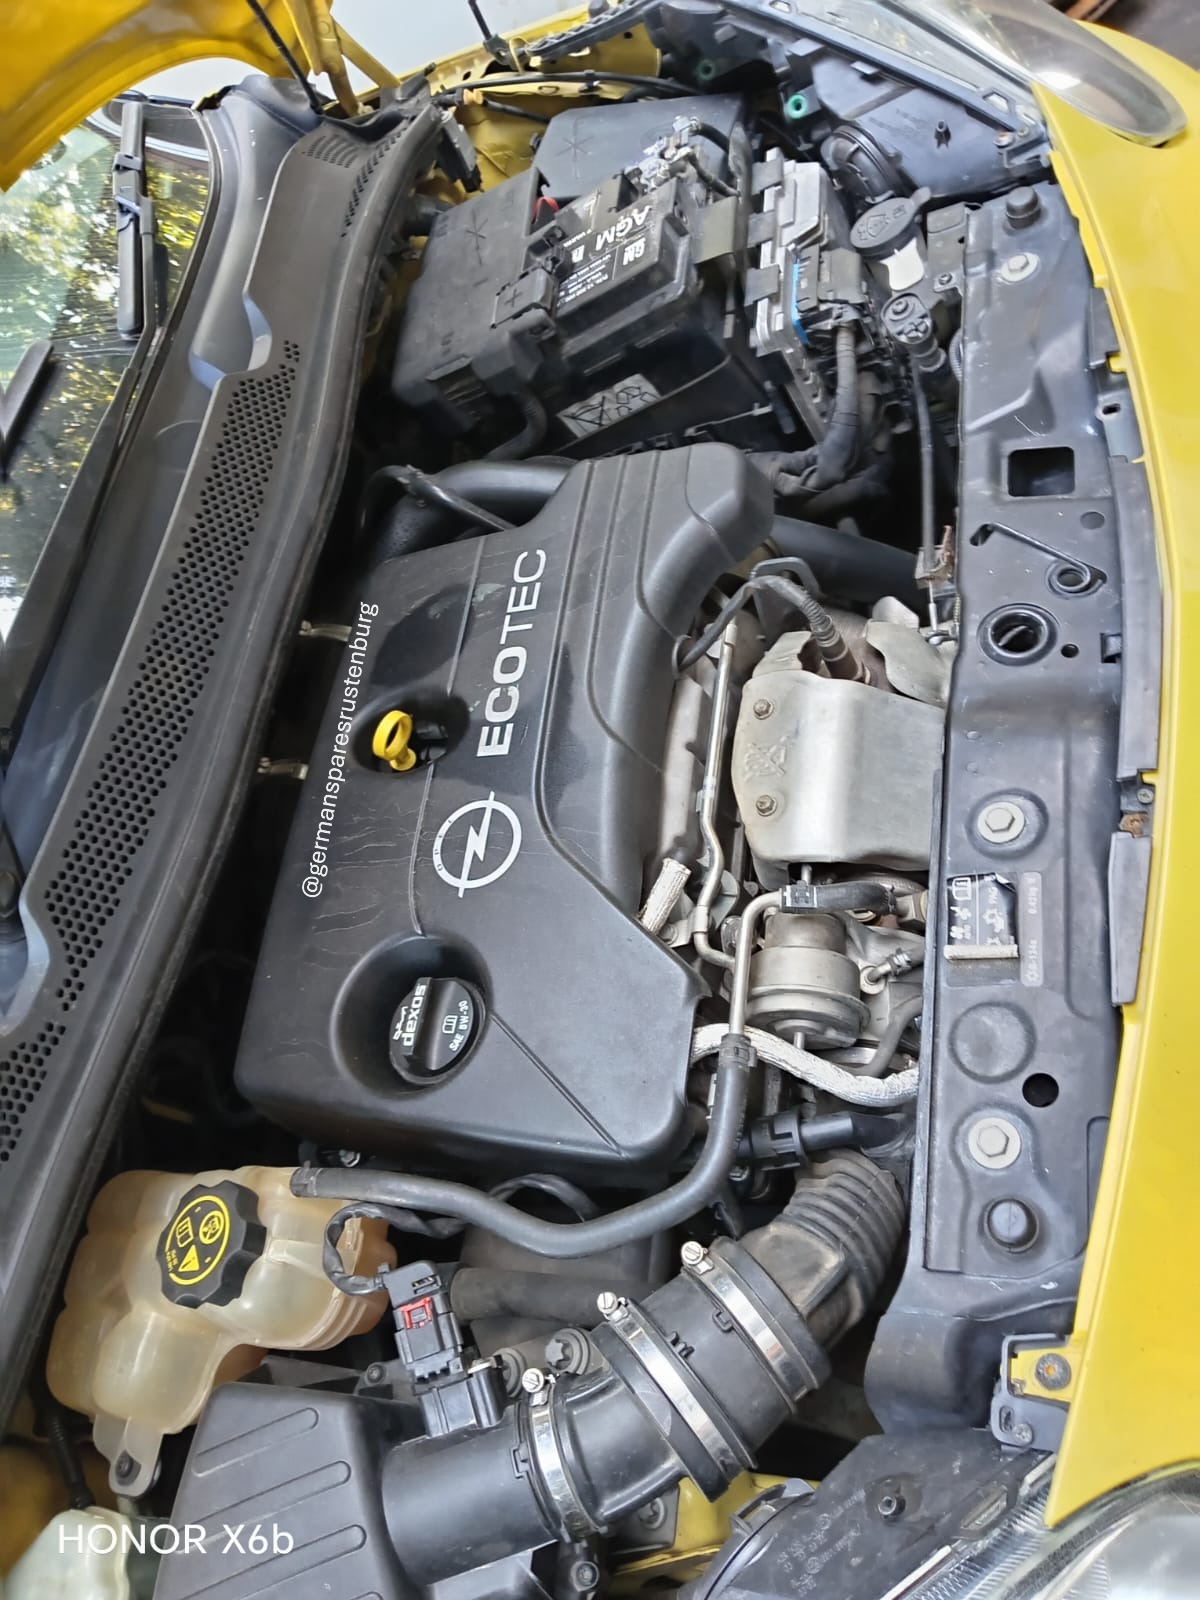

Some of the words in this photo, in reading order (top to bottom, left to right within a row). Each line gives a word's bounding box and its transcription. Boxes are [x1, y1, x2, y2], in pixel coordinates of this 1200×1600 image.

[595, 205, 652, 251] AGM
[623, 237, 647, 266] GM
[475, 548, 548, 758] ECOTEC
[401, 984, 427, 1047] dexos
[449, 1033, 464, 1052] SAE
